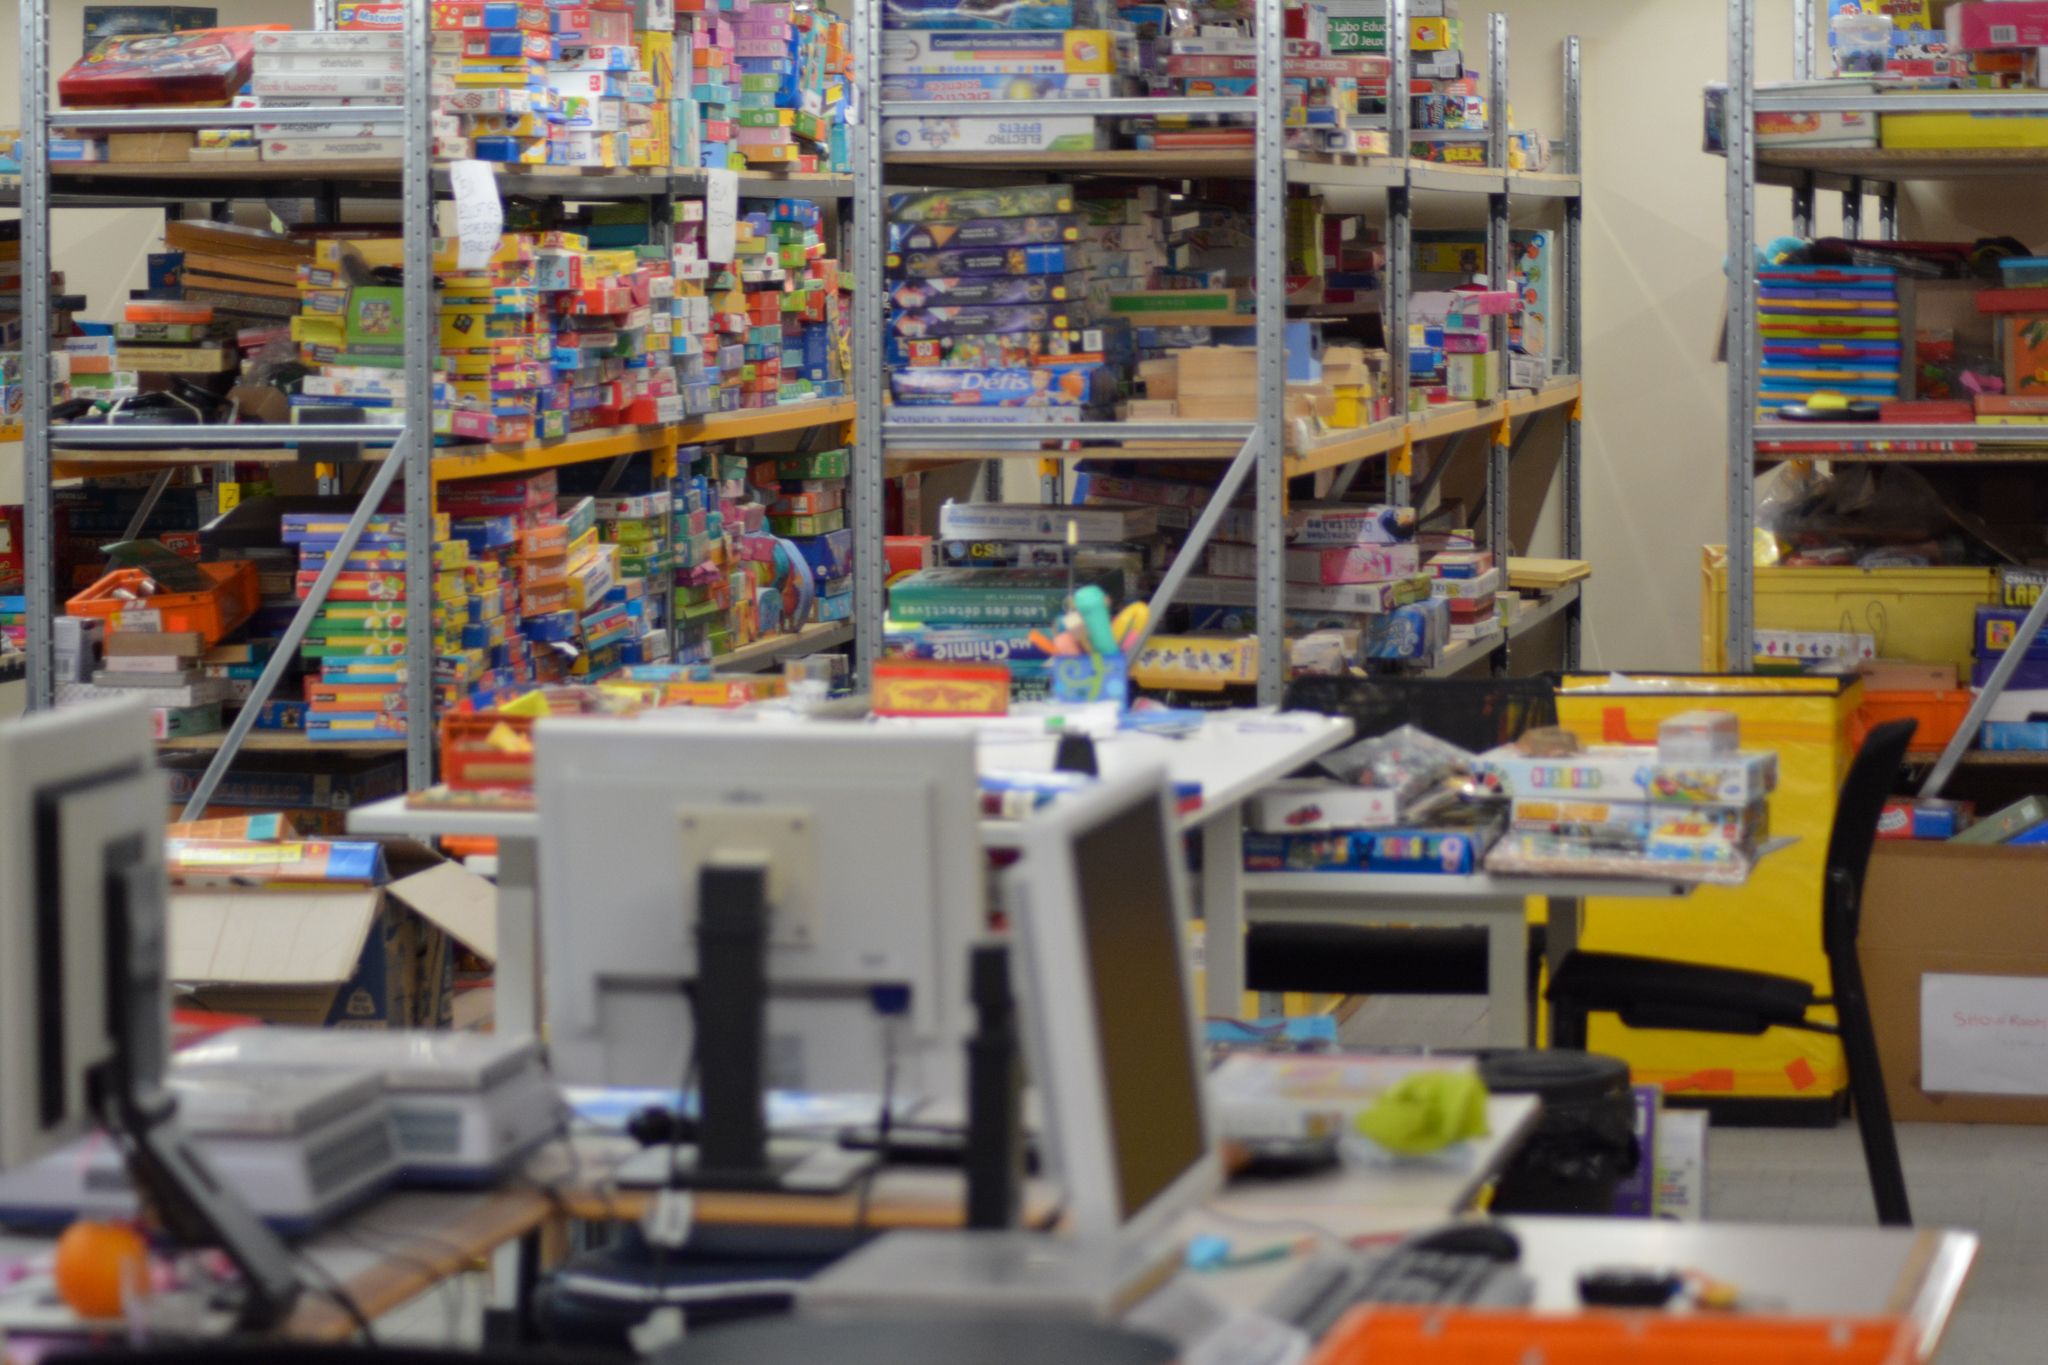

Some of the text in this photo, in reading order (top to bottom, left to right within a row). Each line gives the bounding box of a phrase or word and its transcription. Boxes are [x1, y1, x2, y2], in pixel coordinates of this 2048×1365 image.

[358, 10, 404, 23] Materne
[1335, 20, 1361, 32] Labo
[1363, 20, 1387, 32] Educ
[1340, 32, 1384, 47] 20 Jeux
[998, 122, 1042, 134] EFFETS
[1443, 148, 1483, 162] REX
[917, 342, 933, 357] GO
[960, 371, 1030, 390] Défis
[2005, 575, 2048, 586] CHALL
[2005, 584, 2045, 607] LAB
[899, 604, 1048, 618] Labo des détectives
[931, 640, 1010, 661] Chimie
